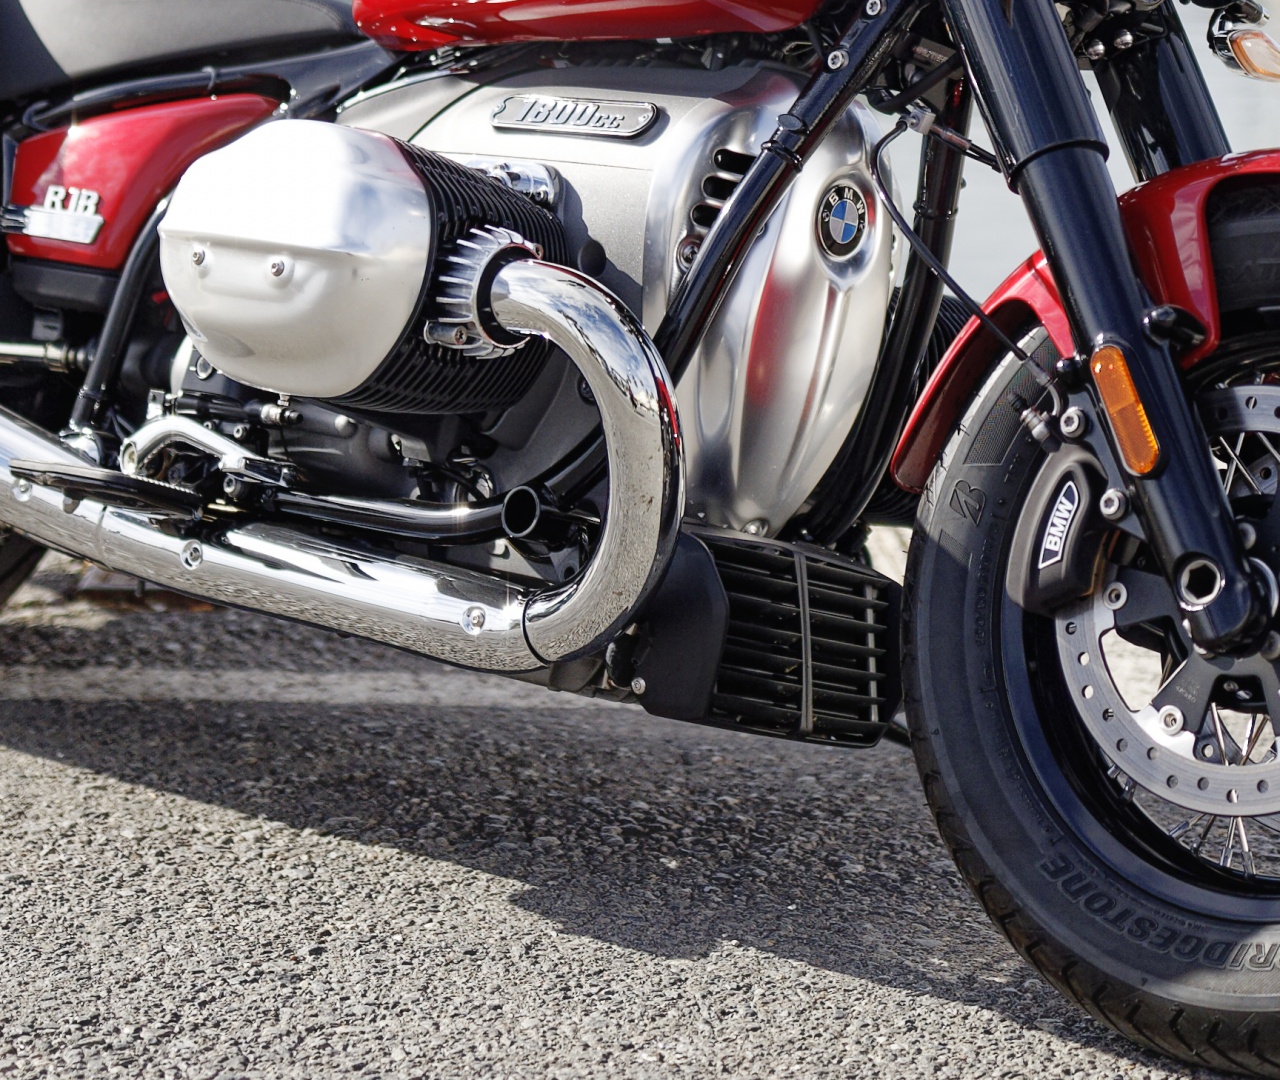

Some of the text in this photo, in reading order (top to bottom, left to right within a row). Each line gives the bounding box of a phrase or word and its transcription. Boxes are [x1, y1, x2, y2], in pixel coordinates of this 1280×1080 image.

[516, 94, 625, 129] 1800cc
[43, 184, 100, 216] R18
[829, 187, 865, 214] BMW
[1045, 496, 1074, 551] BMW
